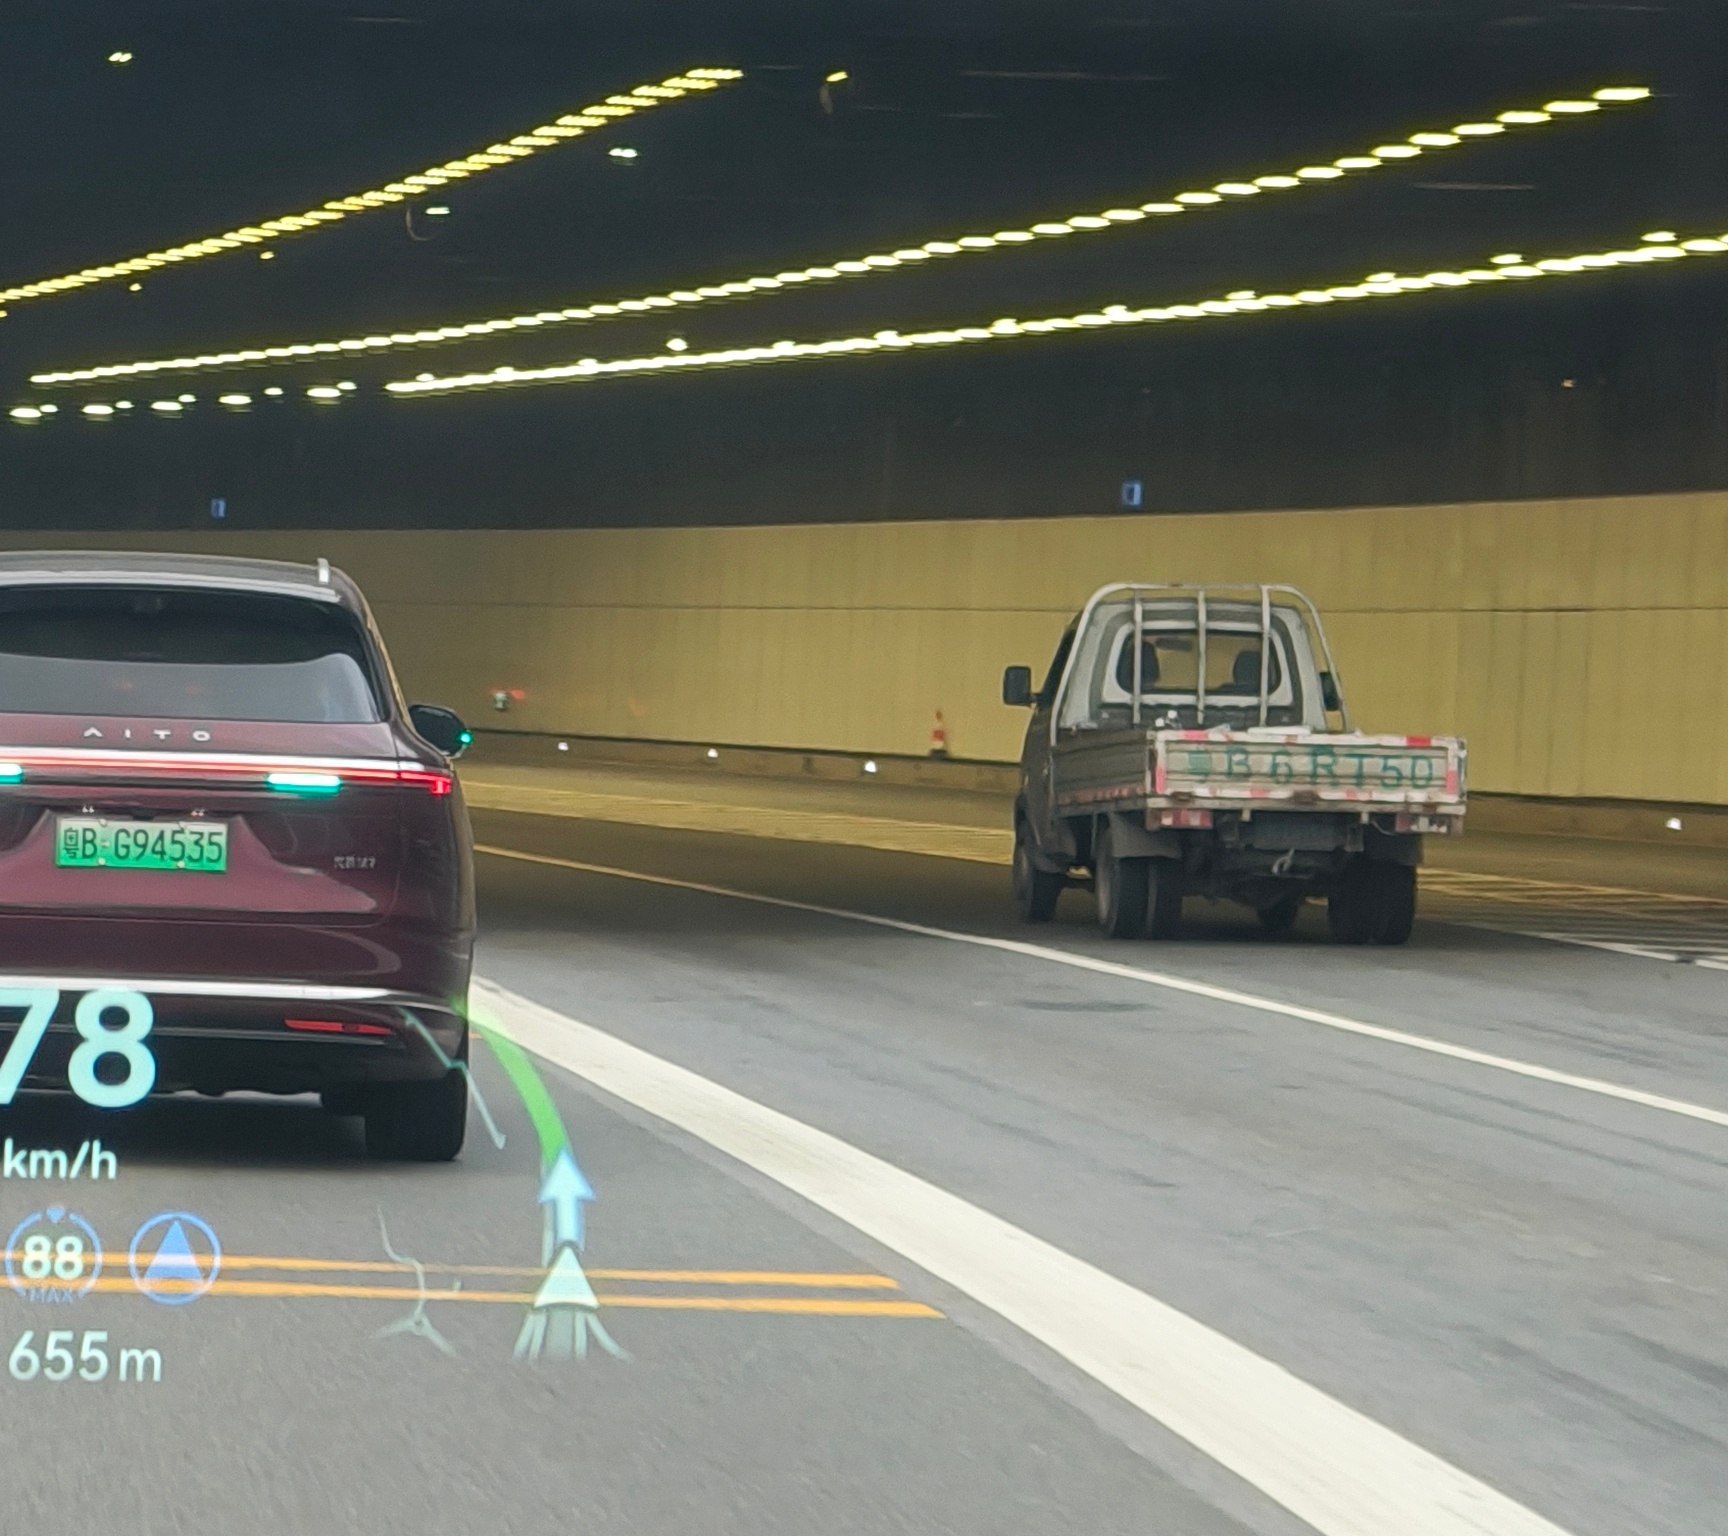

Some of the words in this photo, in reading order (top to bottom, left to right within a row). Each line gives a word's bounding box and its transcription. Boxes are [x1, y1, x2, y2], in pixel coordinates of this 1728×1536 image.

[83, 726, 211, 742] AITO
[3, 1138, 118, 1180] km/h
[22, 1235, 84, 1280] 88
